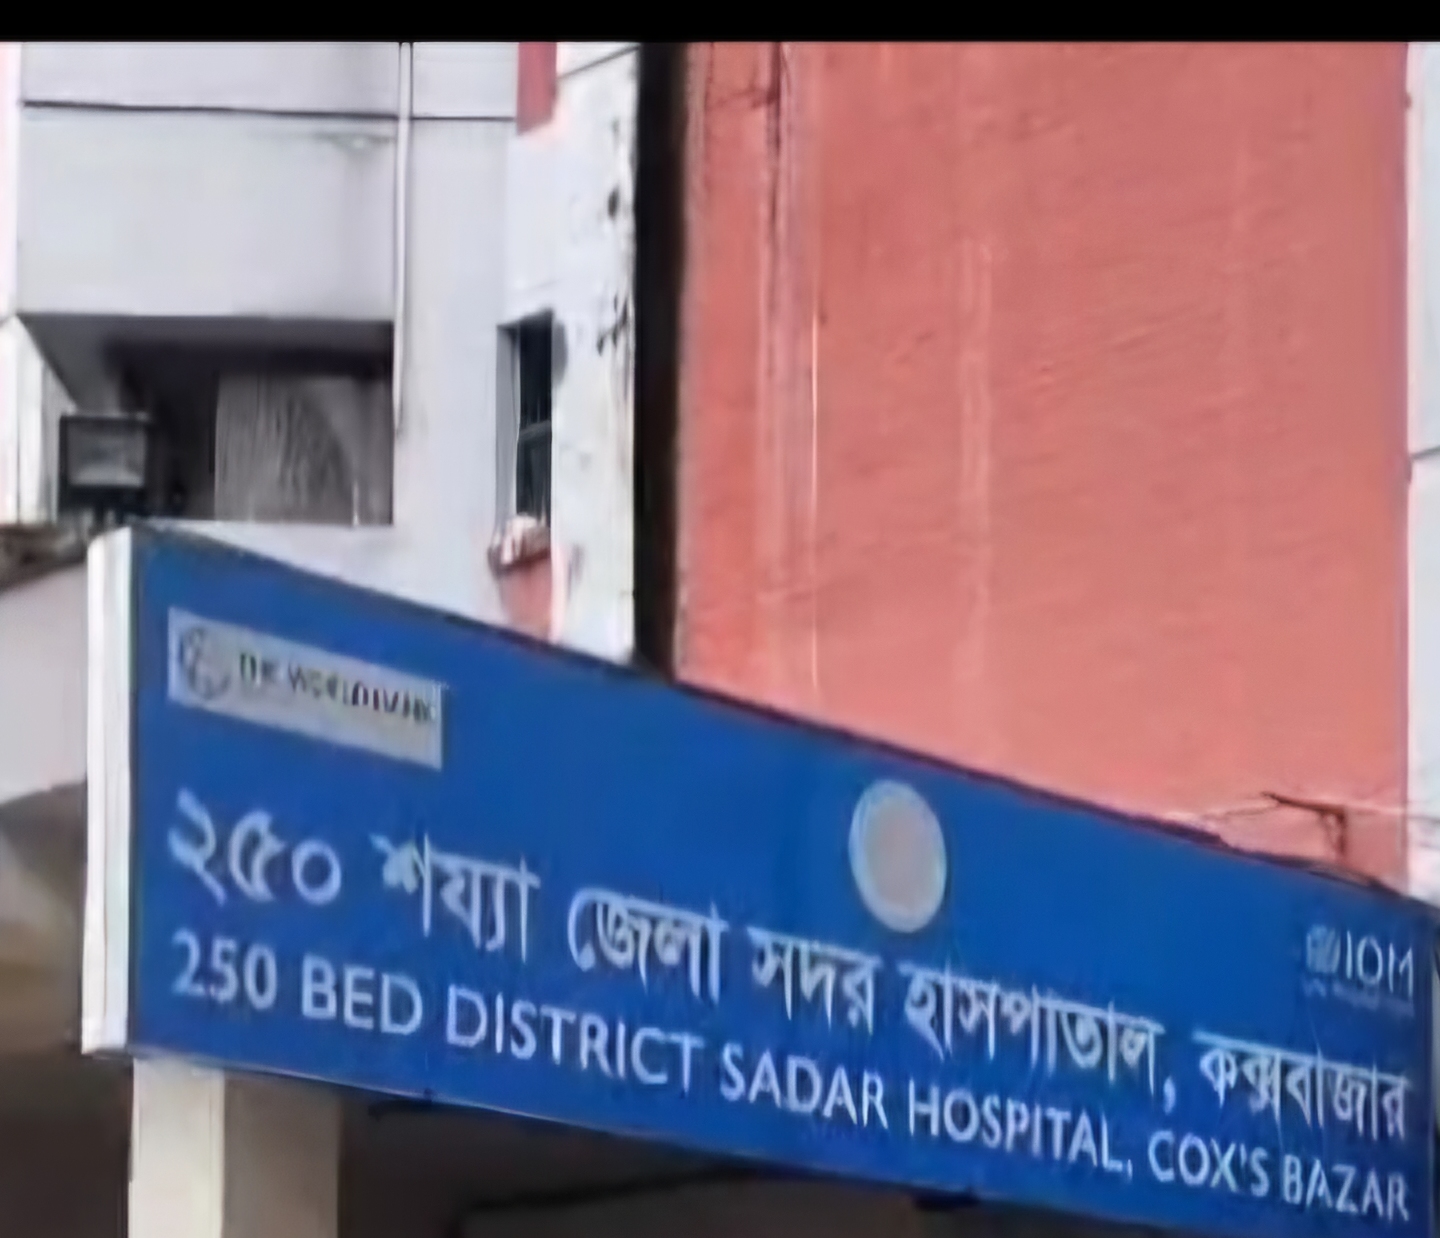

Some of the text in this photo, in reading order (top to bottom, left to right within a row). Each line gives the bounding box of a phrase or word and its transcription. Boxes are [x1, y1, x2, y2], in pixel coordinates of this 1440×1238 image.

[166, 787, 1410, 1142] ২৫০ শয্যা জেলা সদর হাসপাতাল, কক্সবাজার
[171, 928, 1411, 1222] 250 BED DISTRICT SADAR HOSPITAL, COX'S BAZAR
[1345, 928, 1414, 998] IOM
